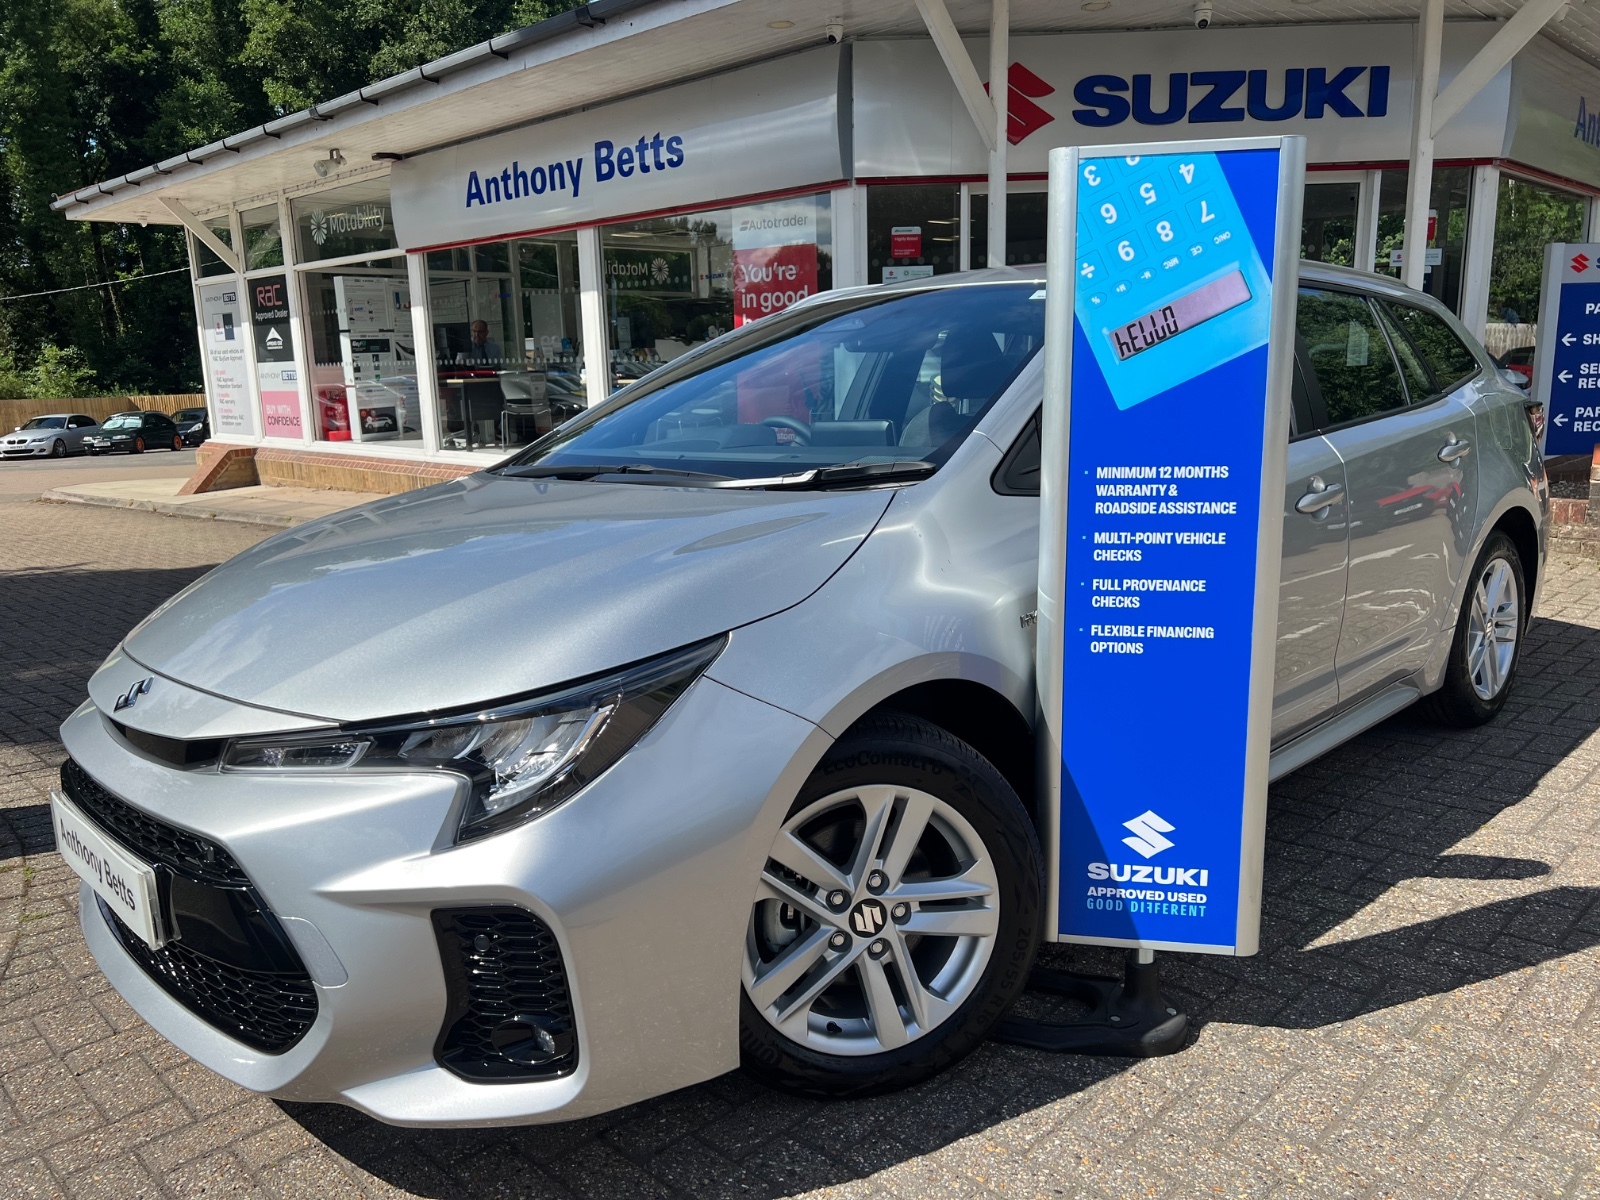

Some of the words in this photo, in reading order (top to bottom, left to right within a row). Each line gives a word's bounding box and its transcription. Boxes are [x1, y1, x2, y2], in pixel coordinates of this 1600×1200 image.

[1072, 65, 1391, 128] SUZUKI
[466, 158, 583, 208] Anthony
[594, 132, 684, 182] Betts
[329, 204, 385, 234] Motability
[748, 215, 808, 231] Autotrader
[1156, 221, 1174, 242] 8
[741, 261, 797, 283] You're
[256, 284, 283, 307] RAC
[741, 289, 757, 308] in
[760, 285, 809, 313] good
[268, 416, 301, 426] CONFIDENCE
[1096, 466, 1157, 479] MINIMUM
[1158, 466, 1172, 478] 12
[1173, 466, 1229, 478] MONTHS
[1096, 484, 1167, 496] WARRANTY
[1168, 484, 1178, 497] &
[1095, 502, 1157, 514] ROADSIDE
[1158, 502, 1237, 514] ASSISTANCE
[1094, 532, 1173, 544] MULTI-POINT
[1174, 533, 1226, 545] VEHICLE
[1093, 549, 1142, 562] CHECKS
[1092, 579, 1121, 591] FULL
[1122, 579, 1206, 592] PROVENANCE
[1092, 596, 1140, 608] CHECKS
[1091, 625, 1145, 638] FLEXIBLE
[1146, 626, 1214, 639] FINANCING
[1090, 641, 1144, 654] OPTIONS
[60, 818, 103, 884] Anthony
[103, 857, 136, 911] Betts
[1087, 862, 1209, 887] SUZUKI
[1087, 886, 1165, 901] APPROVED
[1167, 891, 1207, 904] USED
[1086, 898, 1123, 911] GOOD
[1130, 901, 1207, 917] DIFFERENT
